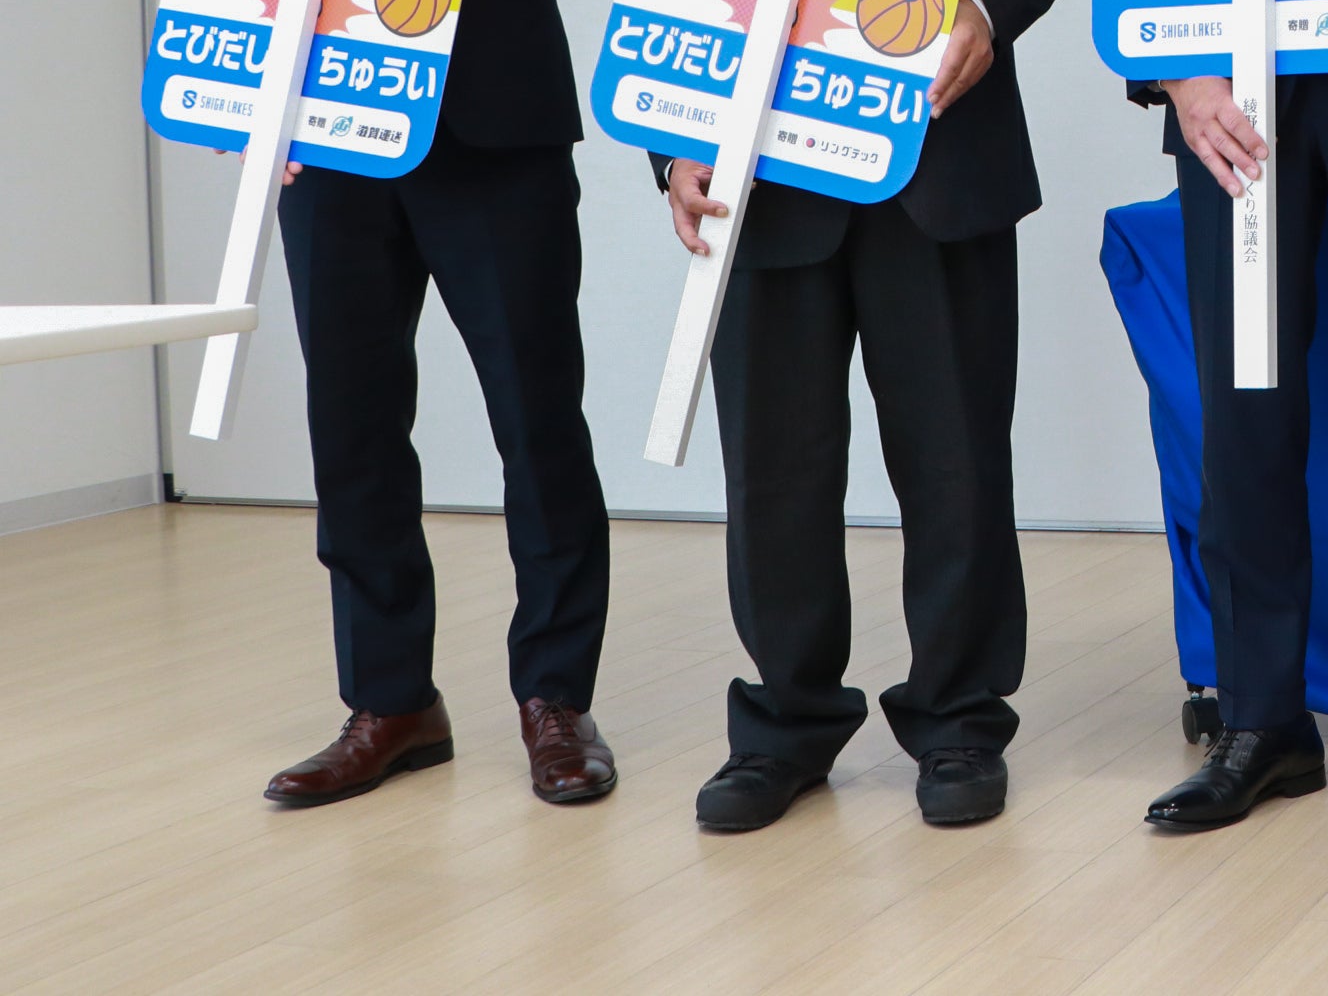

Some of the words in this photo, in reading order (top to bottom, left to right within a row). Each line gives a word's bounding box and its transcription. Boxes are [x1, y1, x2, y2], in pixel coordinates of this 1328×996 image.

[1162, 24, 1190, 39] SHIGA
[1191, 22, 1222, 38] LAKES
[1288, 19, 1308, 32] 寄贈
[157, 20, 267, 74] とびだし
[610, 16, 741, 81] とびだし
[318, 46, 436, 100] ちゅうい
[200, 96, 225, 111] SHIGA
[227, 100, 253, 116] LAKES
[790, 59, 923, 124] ちゅうい
[656, 98, 685, 117] SHIGA
[686, 106, 716, 126] LAKES
[308, 115, 326, 128] 寄贈
[356, 124, 402, 144] 滋賀運送
[777, 130, 798, 146] 寄贈
[821, 140, 879, 165] リングテック
